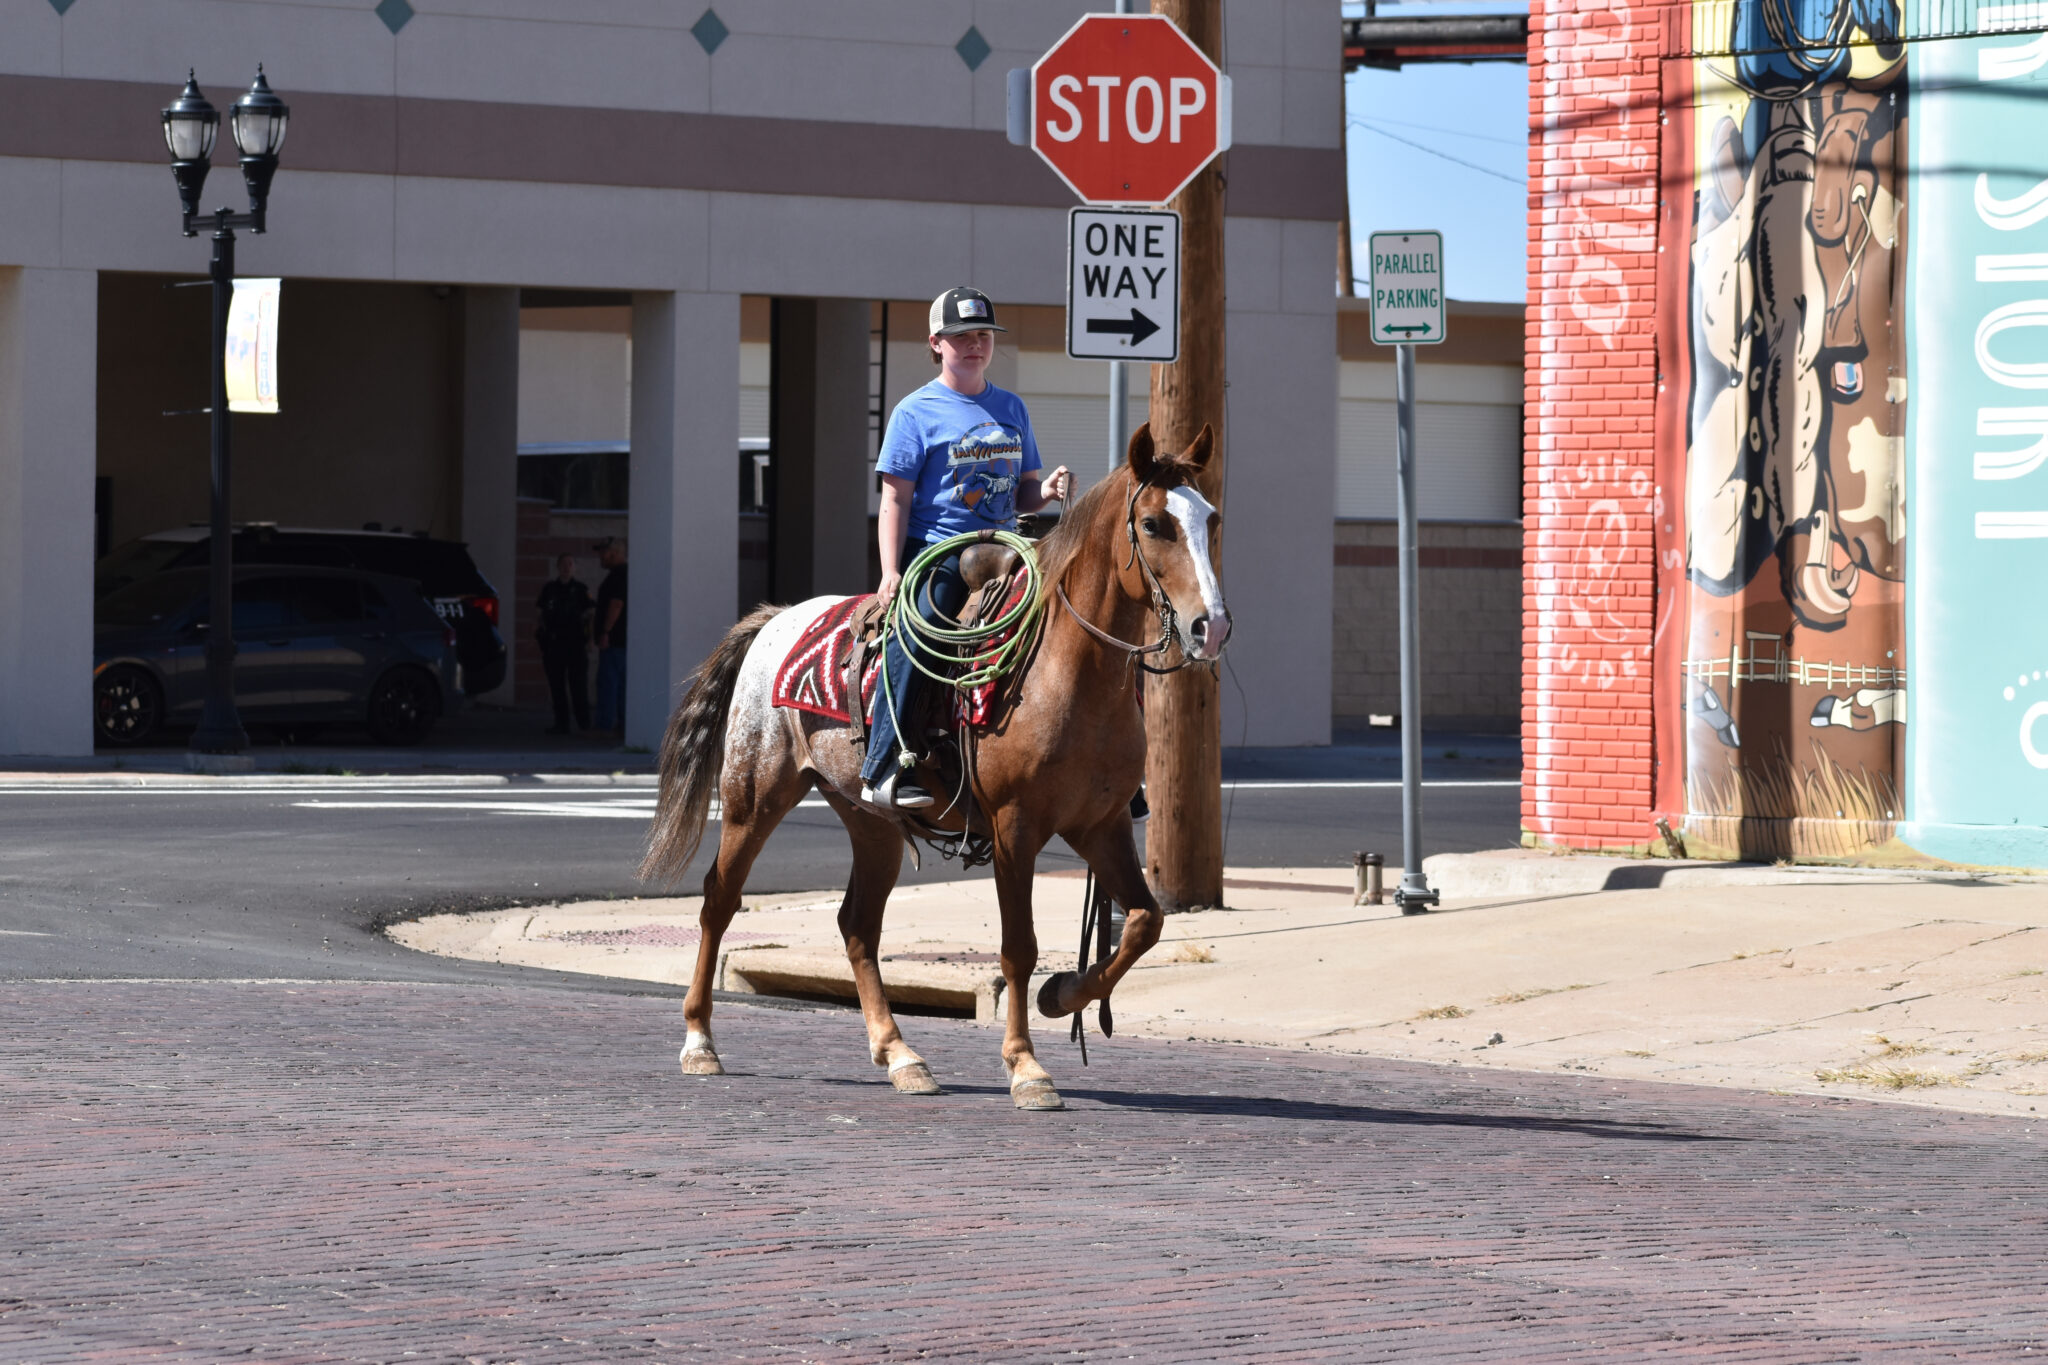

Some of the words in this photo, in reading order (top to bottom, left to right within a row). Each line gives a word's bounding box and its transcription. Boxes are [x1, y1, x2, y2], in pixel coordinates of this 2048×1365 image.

[1046, 74, 1207, 144] STOP
[1085, 222, 1165, 258] ONE
[1083, 264, 1167, 299] WAY
[1375, 253, 1437, 275] PARALLEL
[1376, 288, 1438, 309] PARKING
[1543, 456, 1683, 570] ISITOR'S
[1547, 612, 1638, 690] UIDE
